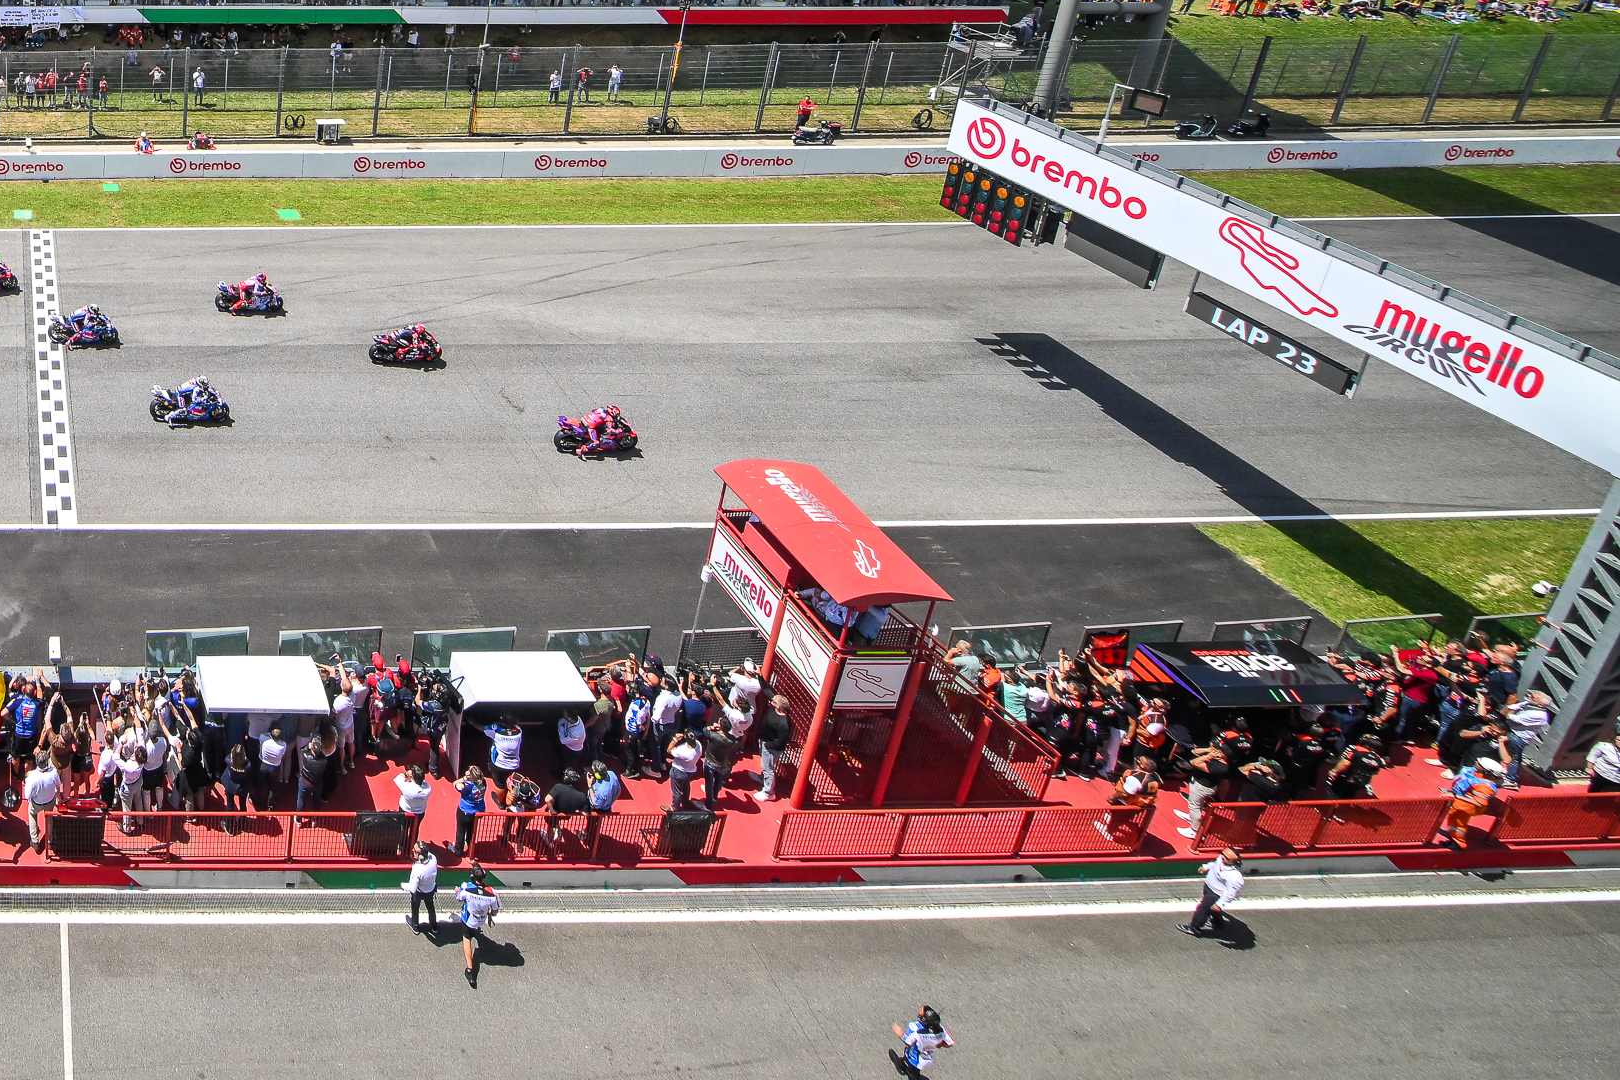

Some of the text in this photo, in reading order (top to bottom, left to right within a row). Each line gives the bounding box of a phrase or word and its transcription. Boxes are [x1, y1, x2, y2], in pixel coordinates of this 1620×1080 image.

[1286, 149, 1339, 161] brembo
[1464, 148, 1515, 159] brembo
[189, 160, 242, 171] brembo
[373, 159, 426, 170] brembo
[556, 157, 609, 168] brembo
[741, 156, 794, 167] brembo
[12, 163, 63, 173] brembo
[1011, 139, 1147, 220] brembo
[1211, 307, 1318, 375] LAP 23
[1373, 299, 1545, 399] mugello
[723, 551, 773, 618] mugello
[1199, 651, 1296, 677] aprilia
